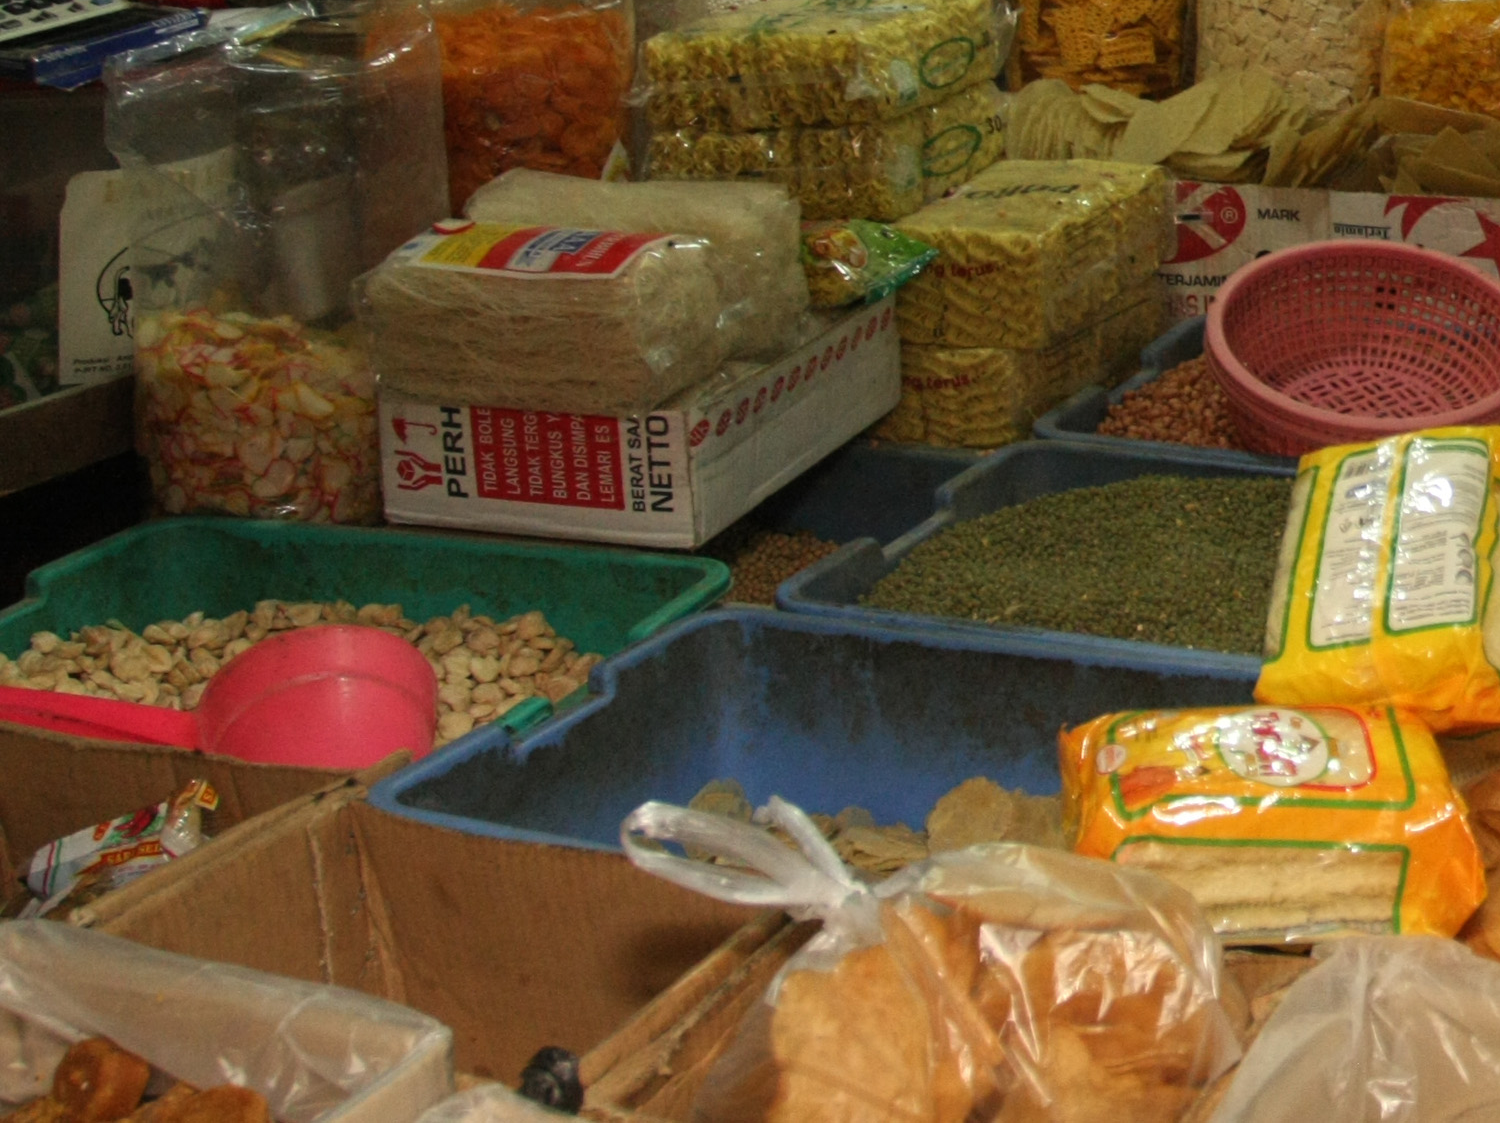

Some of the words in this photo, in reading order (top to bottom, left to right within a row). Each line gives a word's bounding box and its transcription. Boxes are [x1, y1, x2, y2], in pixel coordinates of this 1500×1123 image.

[1257, 207, 1301, 223] MARK
[1333, 224, 1391, 241] Terjamin
[475, 407, 495, 446] BOLE
[573, 413, 590, 468] DISIMPA
[593, 423, 610, 444] ES
[483, 451, 499, 493] TIDAK
[499, 416, 521, 496] LANGSUNG
[530, 454, 545, 498] TIDAK
[548, 429, 569, 500] BUNGKUS
[596, 449, 616, 503] LEMARI
[644, 414, 675, 514] NETTO
[575, 469, 592, 501] DAN
[626, 454, 647, 513] BERAT
